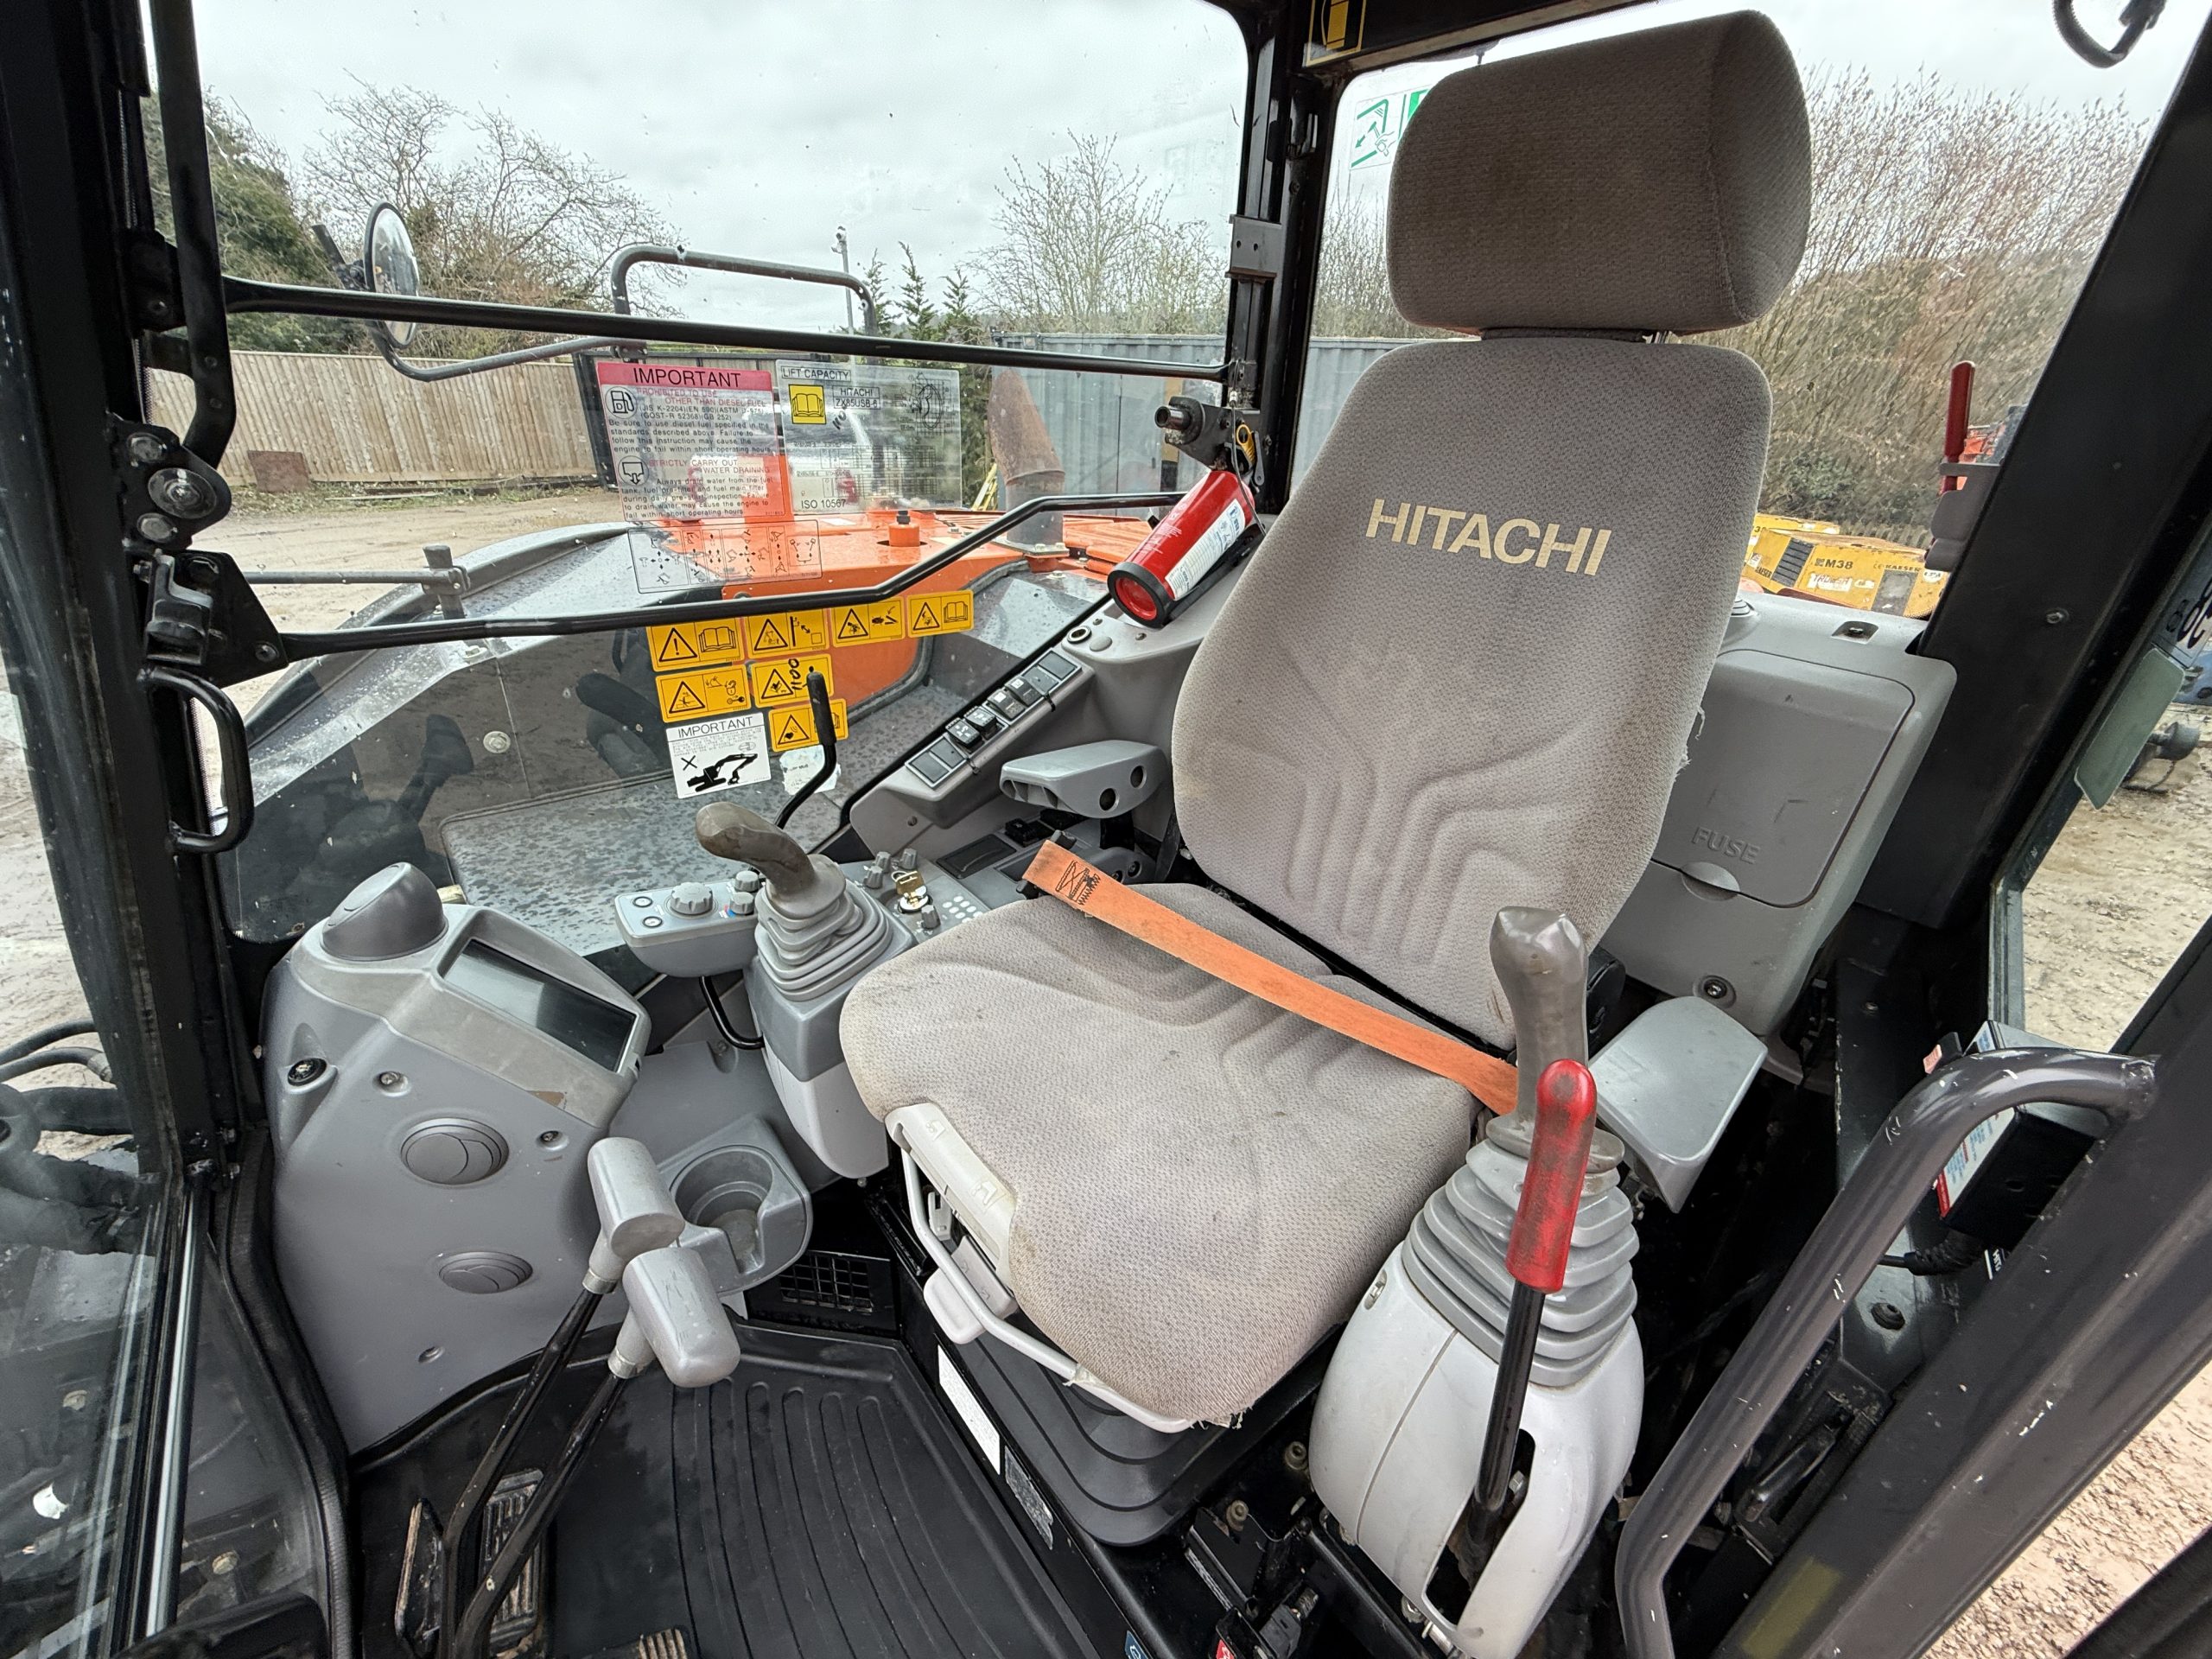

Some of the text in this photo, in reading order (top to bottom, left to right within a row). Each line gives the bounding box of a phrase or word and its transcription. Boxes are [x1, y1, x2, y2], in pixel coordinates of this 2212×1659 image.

[633, 367, 741, 388] IMPORTANT
[782, 369, 849, 380] LIFT CAPACITY
[636, 387, 686, 397] PROHIBITED
[702, 390, 717, 398] USE
[840, 388, 873, 397] HITACHI
[836, 397, 878, 409] ZX85USB-6
[715, 421, 747, 429] specified
[610, 428, 650, 436] standards
[716, 446, 749, 454] operating
[648, 459, 688, 467] STRICTLY
[657, 478, 681, 486] Always
[651, 494, 668, 503] daily
[736, 499, 760, 508] engine
[801, 499, 847, 509] ISO 10567
[688, 509, 721, 518] operating
[1365, 498, 1612, 576] HITACHI
[1825, 558, 1853, 570] M38
[677, 716, 753, 739] IMPORTANT
[1691, 826, 1760, 865] FUSE
